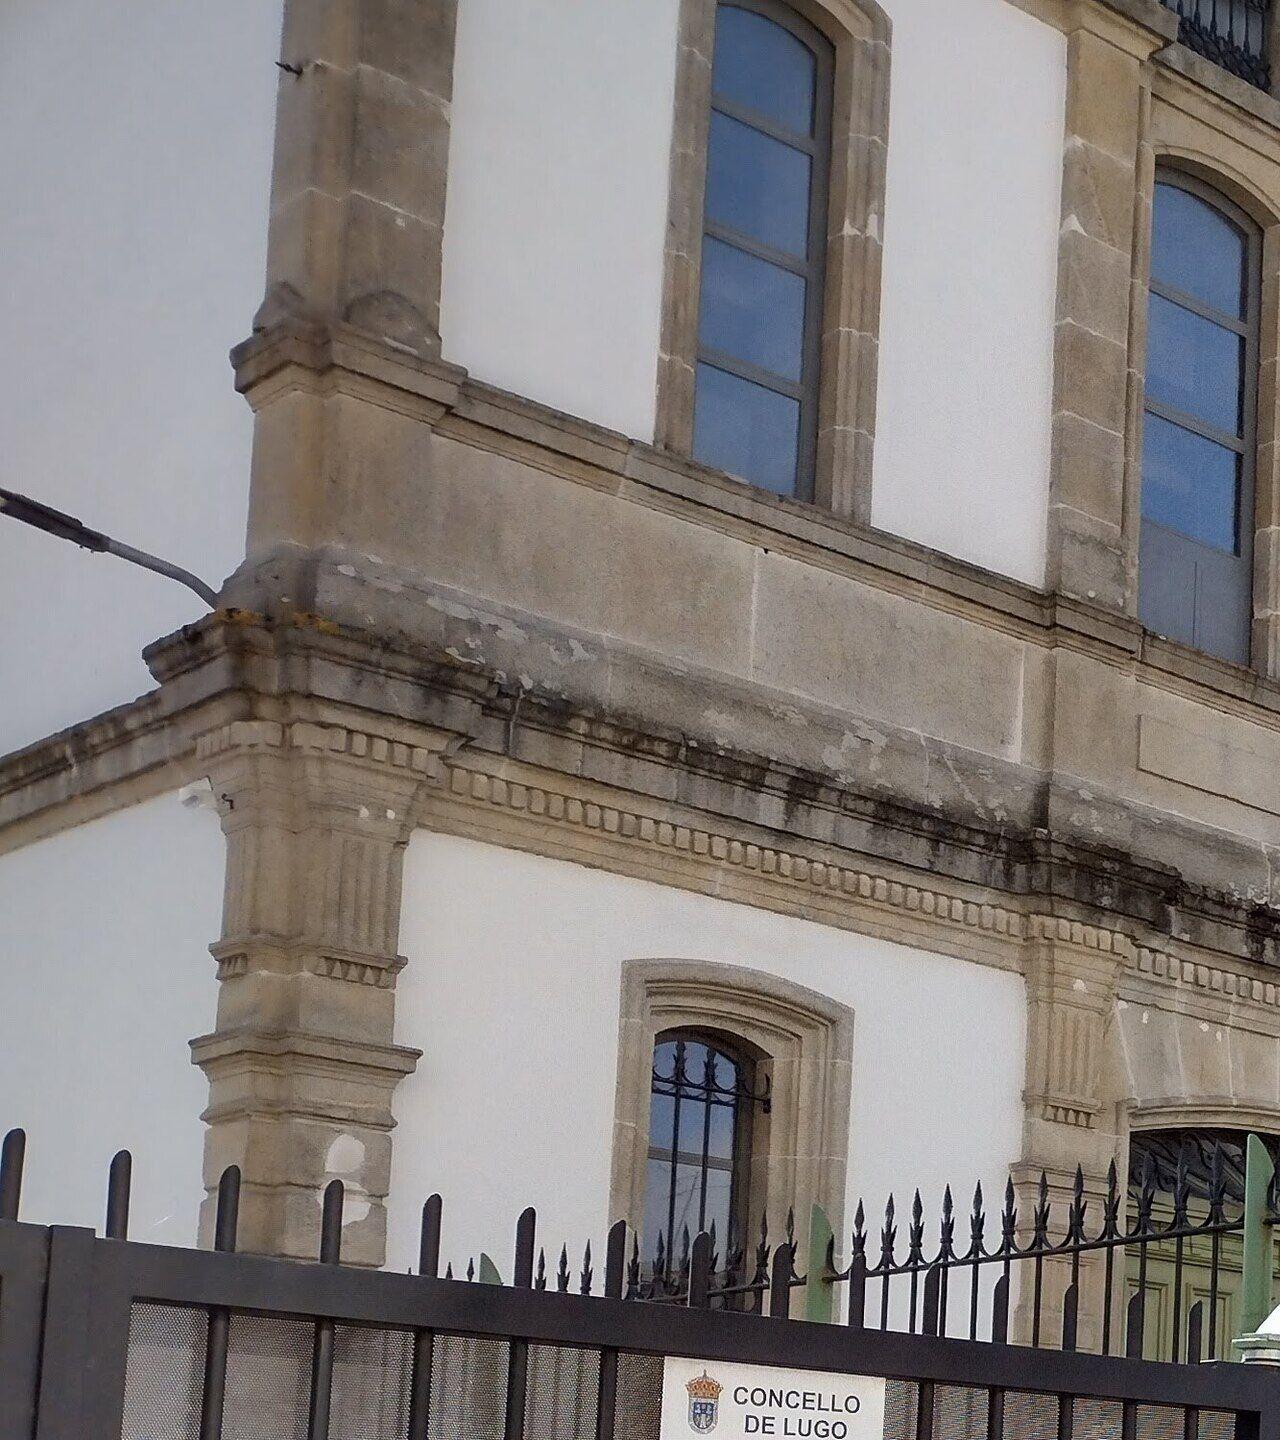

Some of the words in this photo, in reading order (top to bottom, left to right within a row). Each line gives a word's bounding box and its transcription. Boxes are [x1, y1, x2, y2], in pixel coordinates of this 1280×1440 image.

[733, 1386, 861, 1414] CONCELLO
[744, 1414, 776, 1435] DE
[783, 1417, 848, 1440] LUGO
